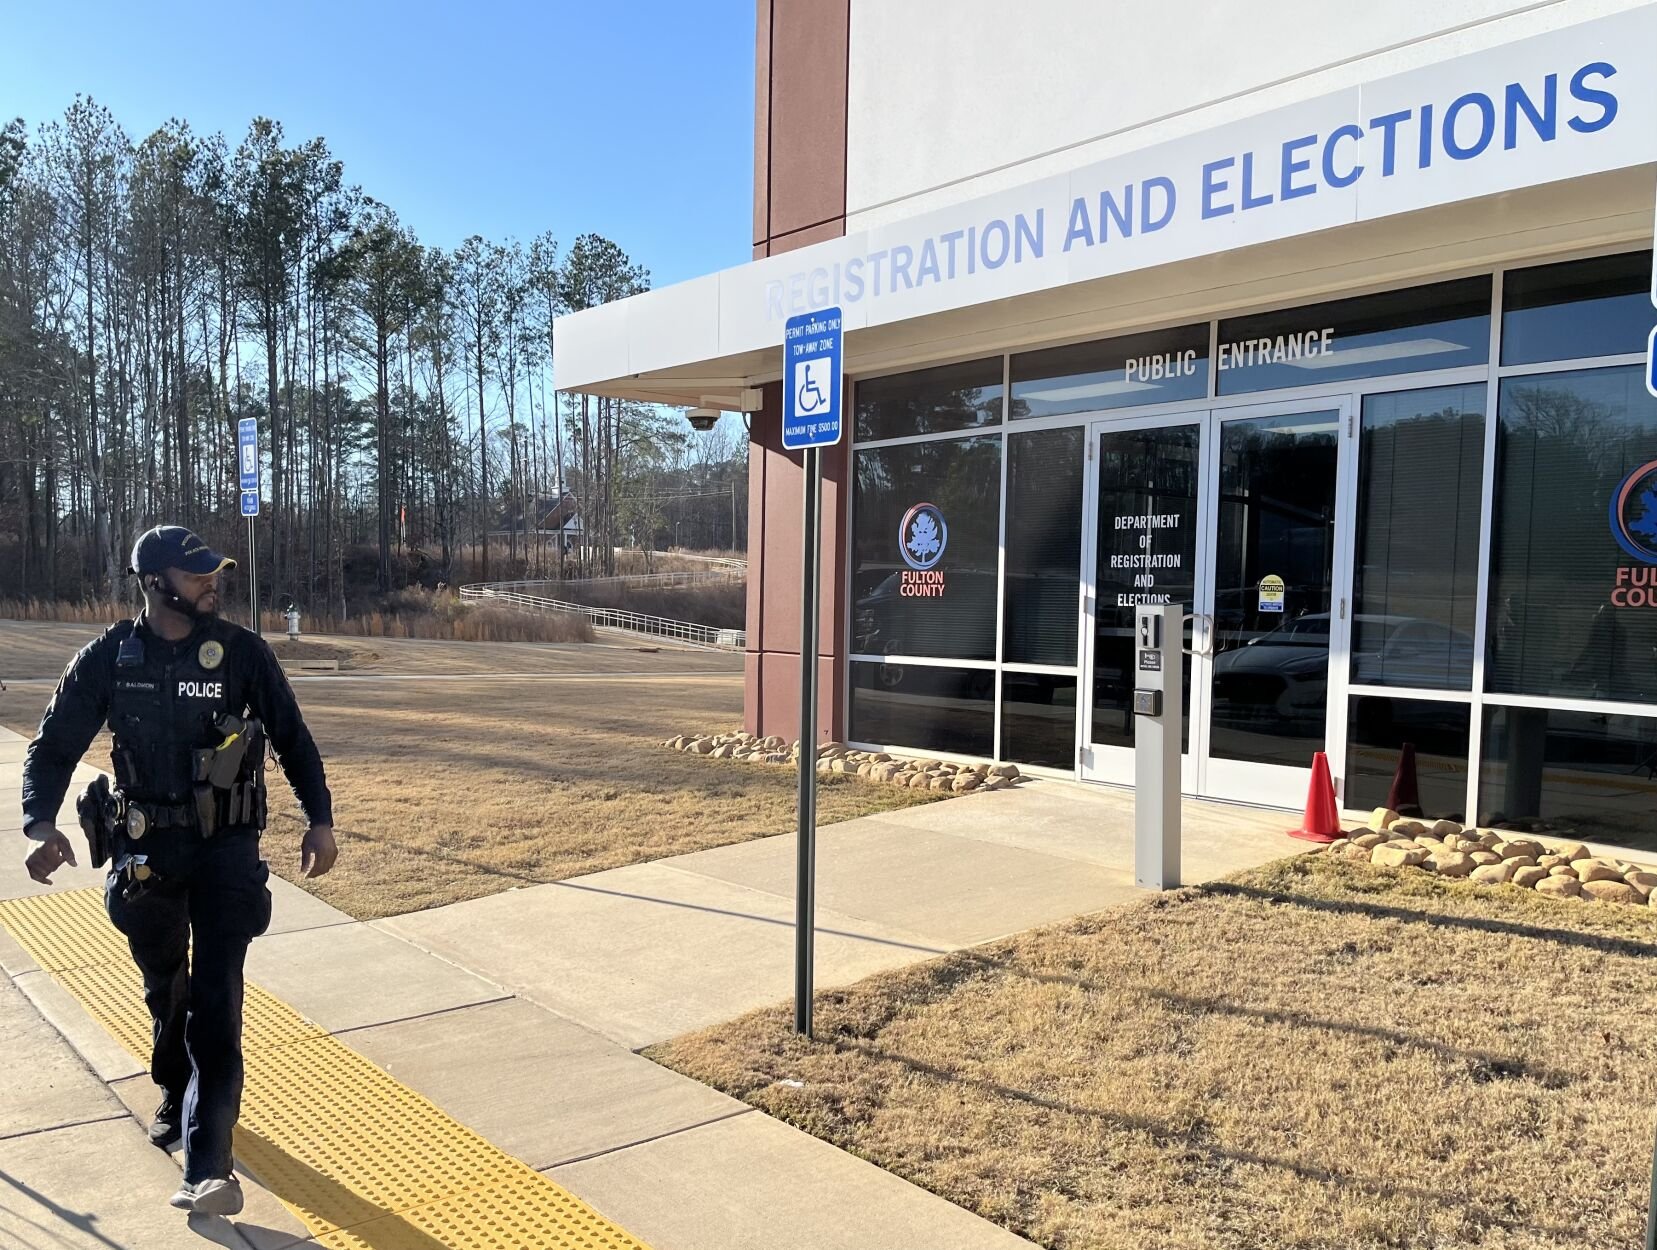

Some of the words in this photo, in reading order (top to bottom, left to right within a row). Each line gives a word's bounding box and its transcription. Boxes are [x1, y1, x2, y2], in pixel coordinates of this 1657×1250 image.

[765, 207, 1045, 321] REGISTRATION
[1062, 176, 1177, 252] AND
[1201, 62, 1618, 220] ELECTIONS
[786, 326, 804, 339] PERMIT
[806, 320, 827, 336] PARKING
[828, 318, 841, 331] ONLY
[793, 341, 818, 356] TOW-AWAY
[820, 338, 834, 351] ZONE
[1125, 349, 1196, 384] PUBLIC
[1217, 327, 1335, 371] ENTRANCE
[785, 425, 806, 436] MAXIMUM
[1114, 514, 1180, 530] DEPARTMENT
[1139, 535, 1153, 549] OF
[1110, 554, 1181, 568] REGISTRATION
[902, 571, 943, 584] FULTON
[1134, 574, 1154, 588] AND
[900, 584, 945, 597] COUNTY
[178, 681, 222, 698] POLICE
